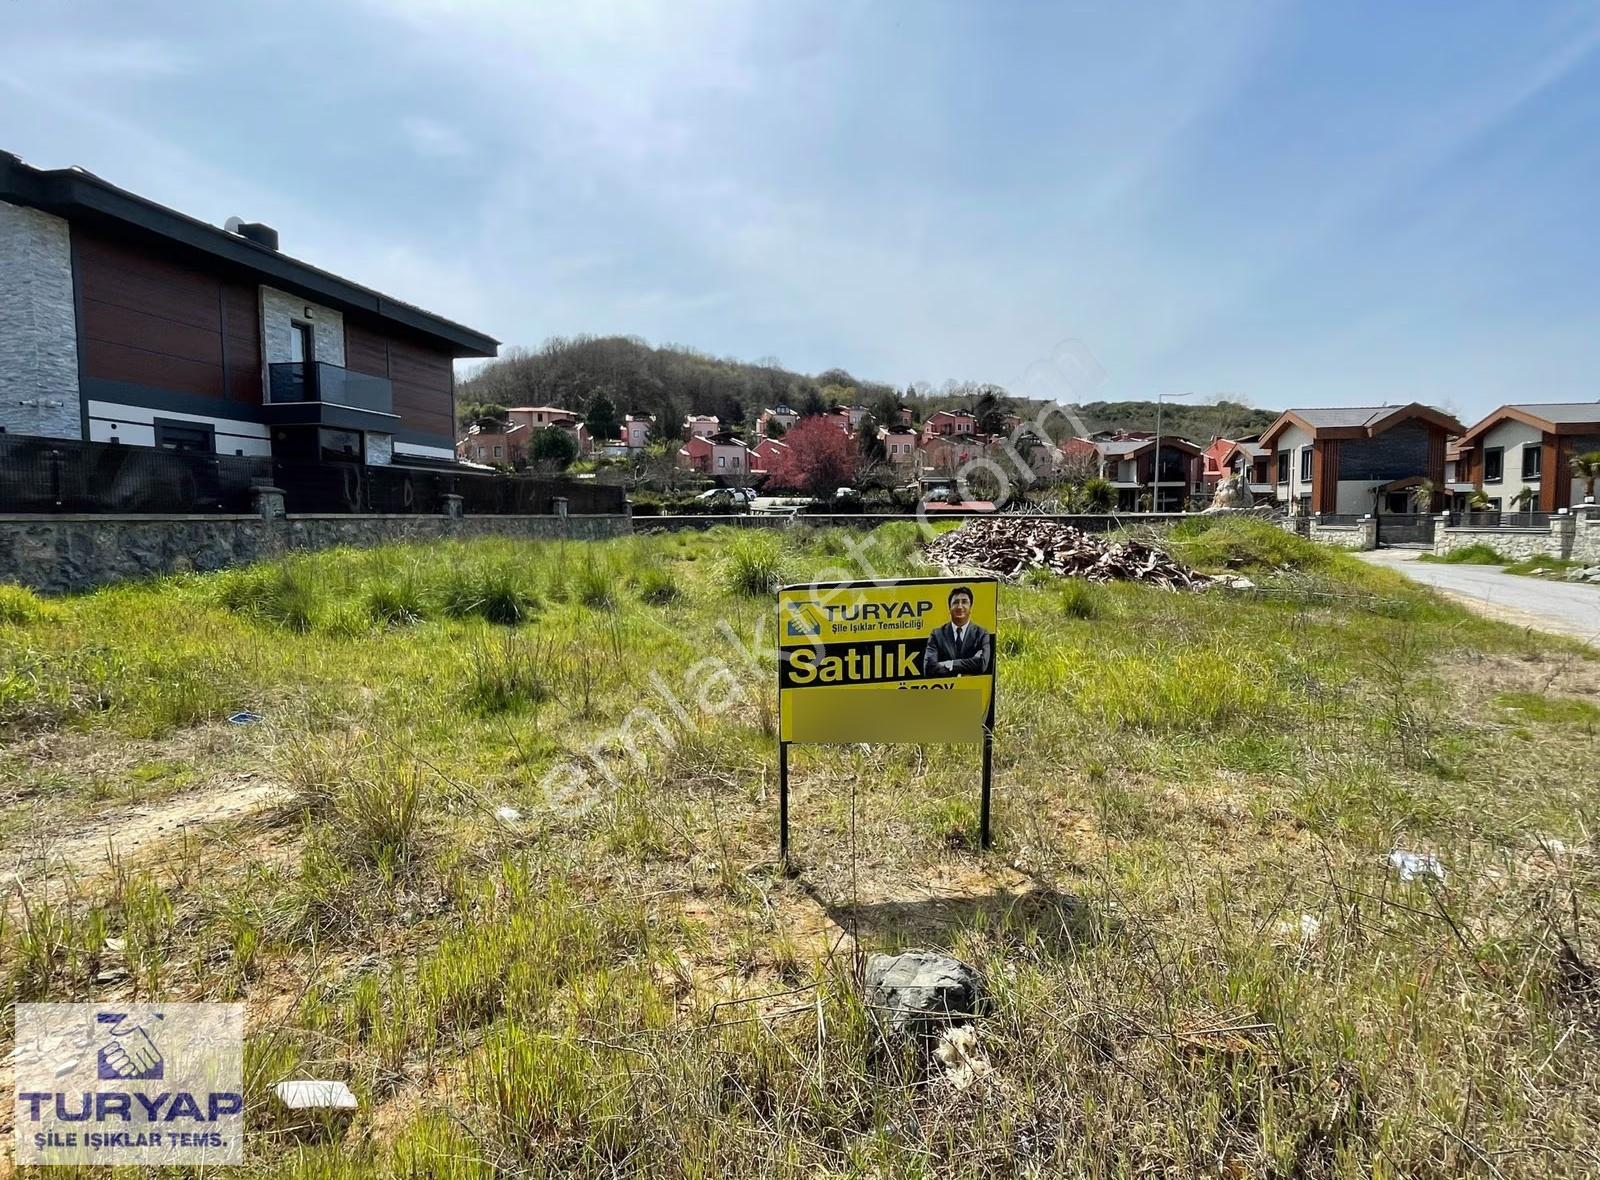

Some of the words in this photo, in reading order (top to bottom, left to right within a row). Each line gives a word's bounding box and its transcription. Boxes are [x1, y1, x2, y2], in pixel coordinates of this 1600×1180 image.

[823, 601, 933, 622] TURYAP
[832, 623, 848, 634] Şile
[850, 622, 876, 634] Işıklar
[878, 619, 924, 631] Temsilciliği
[788, 643, 921, 684] Satılık
